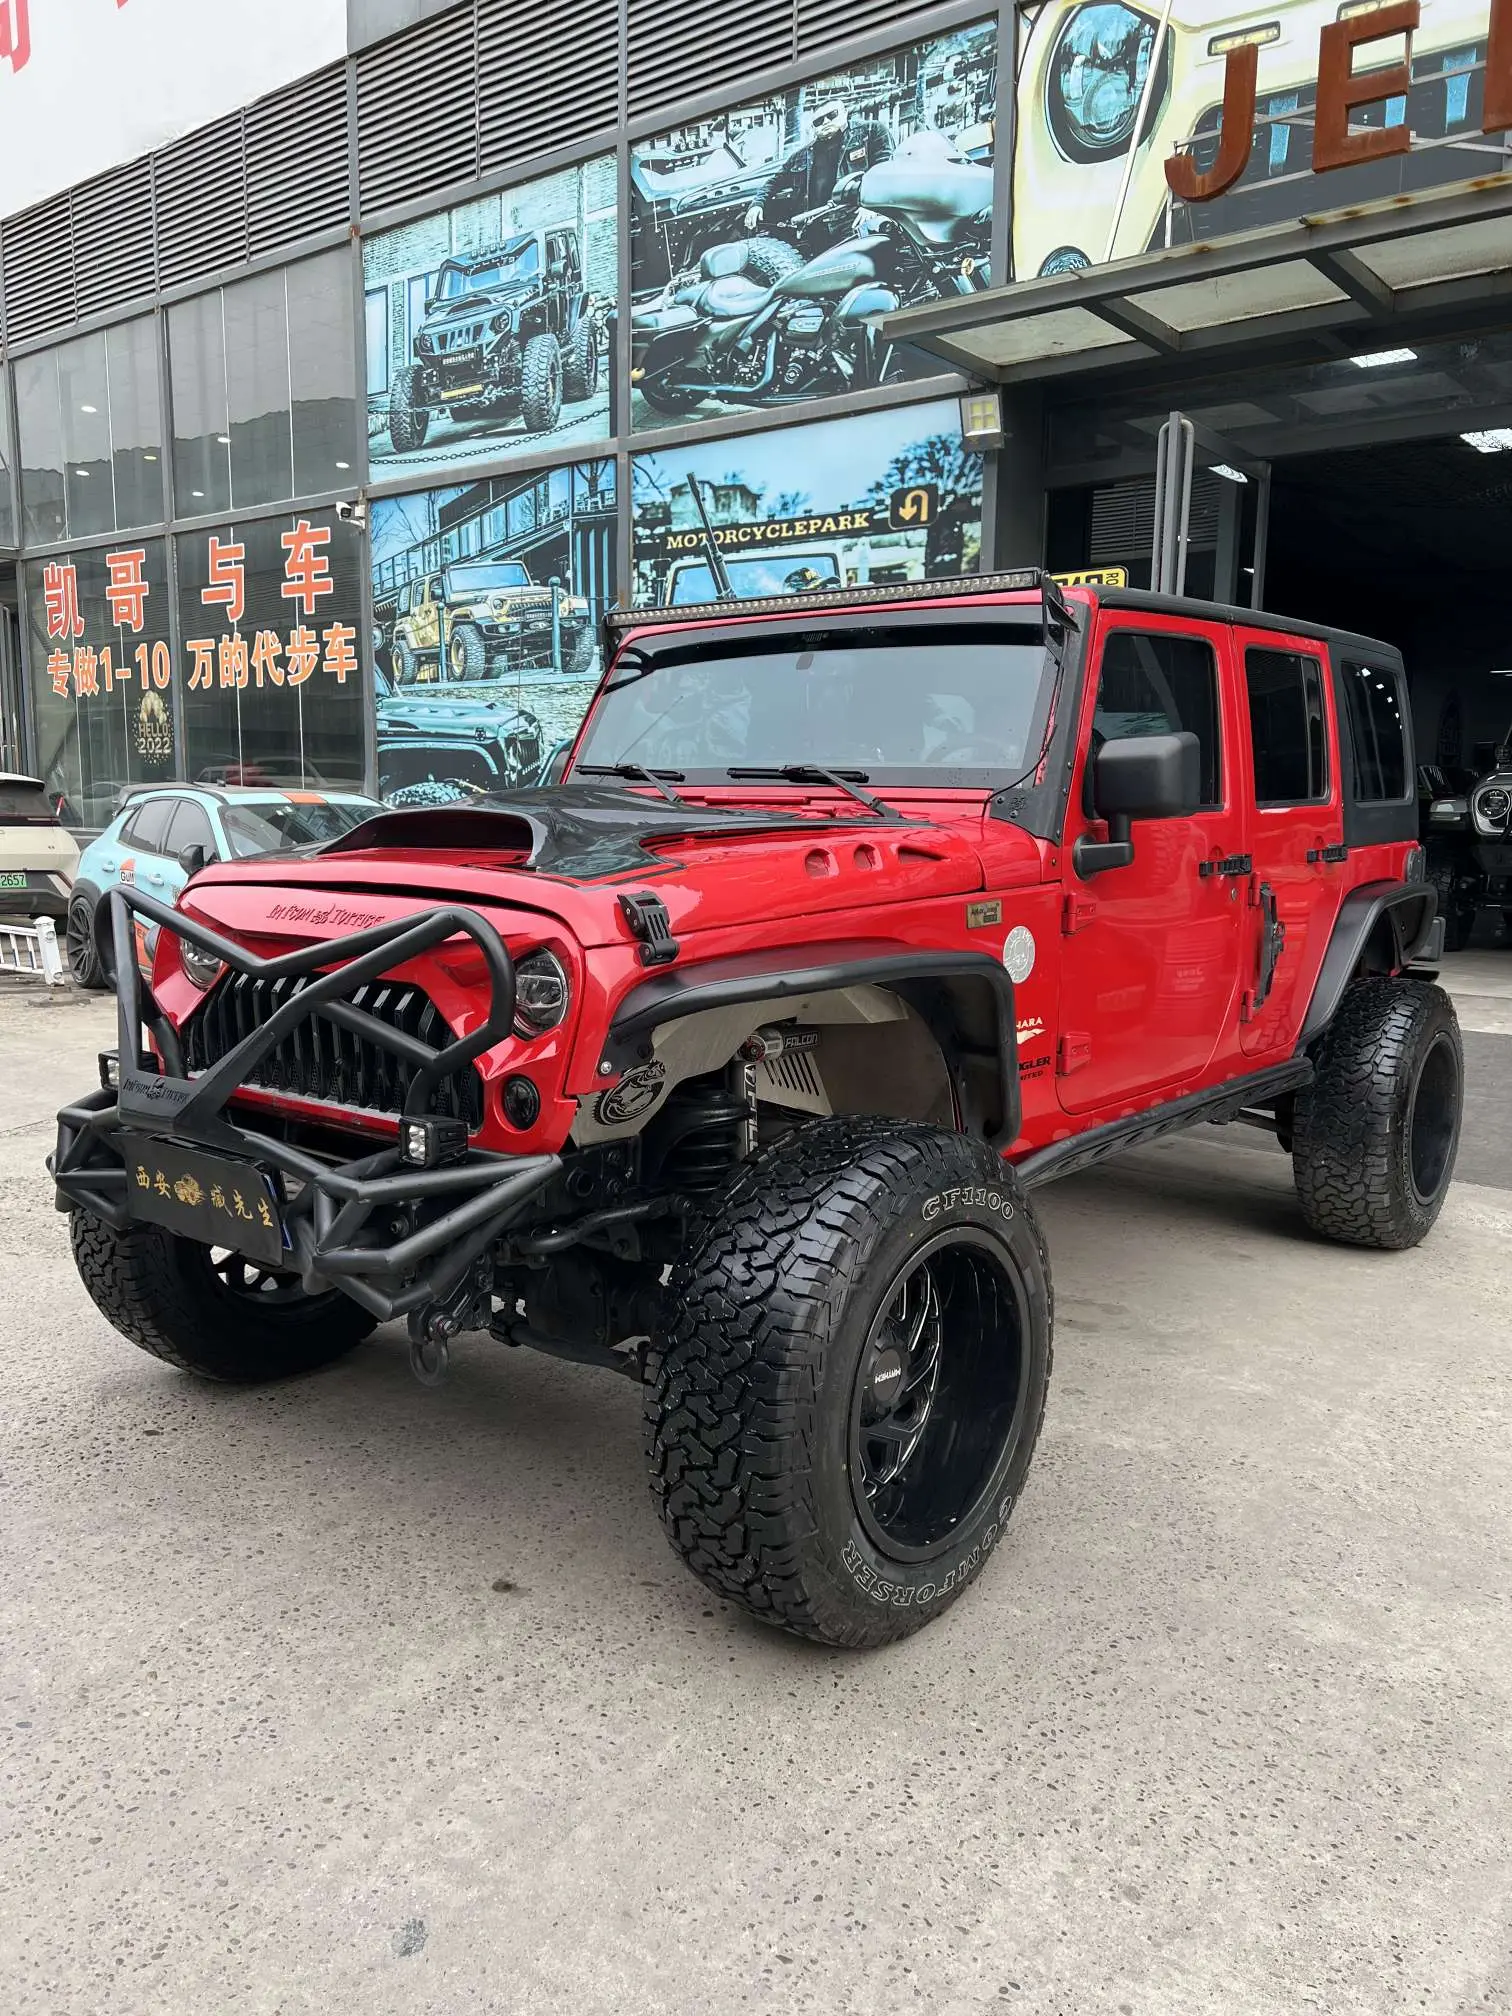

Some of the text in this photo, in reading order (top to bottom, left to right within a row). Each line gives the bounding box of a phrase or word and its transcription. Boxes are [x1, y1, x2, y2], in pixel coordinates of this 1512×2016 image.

[1164, 0, 1512, 202] JE
[666, 512, 870, 550] MOTORCYCLEPARK
[138, 722, 169, 737] HELLO
[138, 737, 171, 754] 2022
[0, 874, 25, 886] 2657
[1016, 1016, 1043, 1030] HARA
[785, 1033, 818, 1048] FALCON
[135, 1165, 172, 1200] 西安
[922, 1186, 1014, 1221] CF1100
[841, 1495, 1012, 1607] COMFORSER
